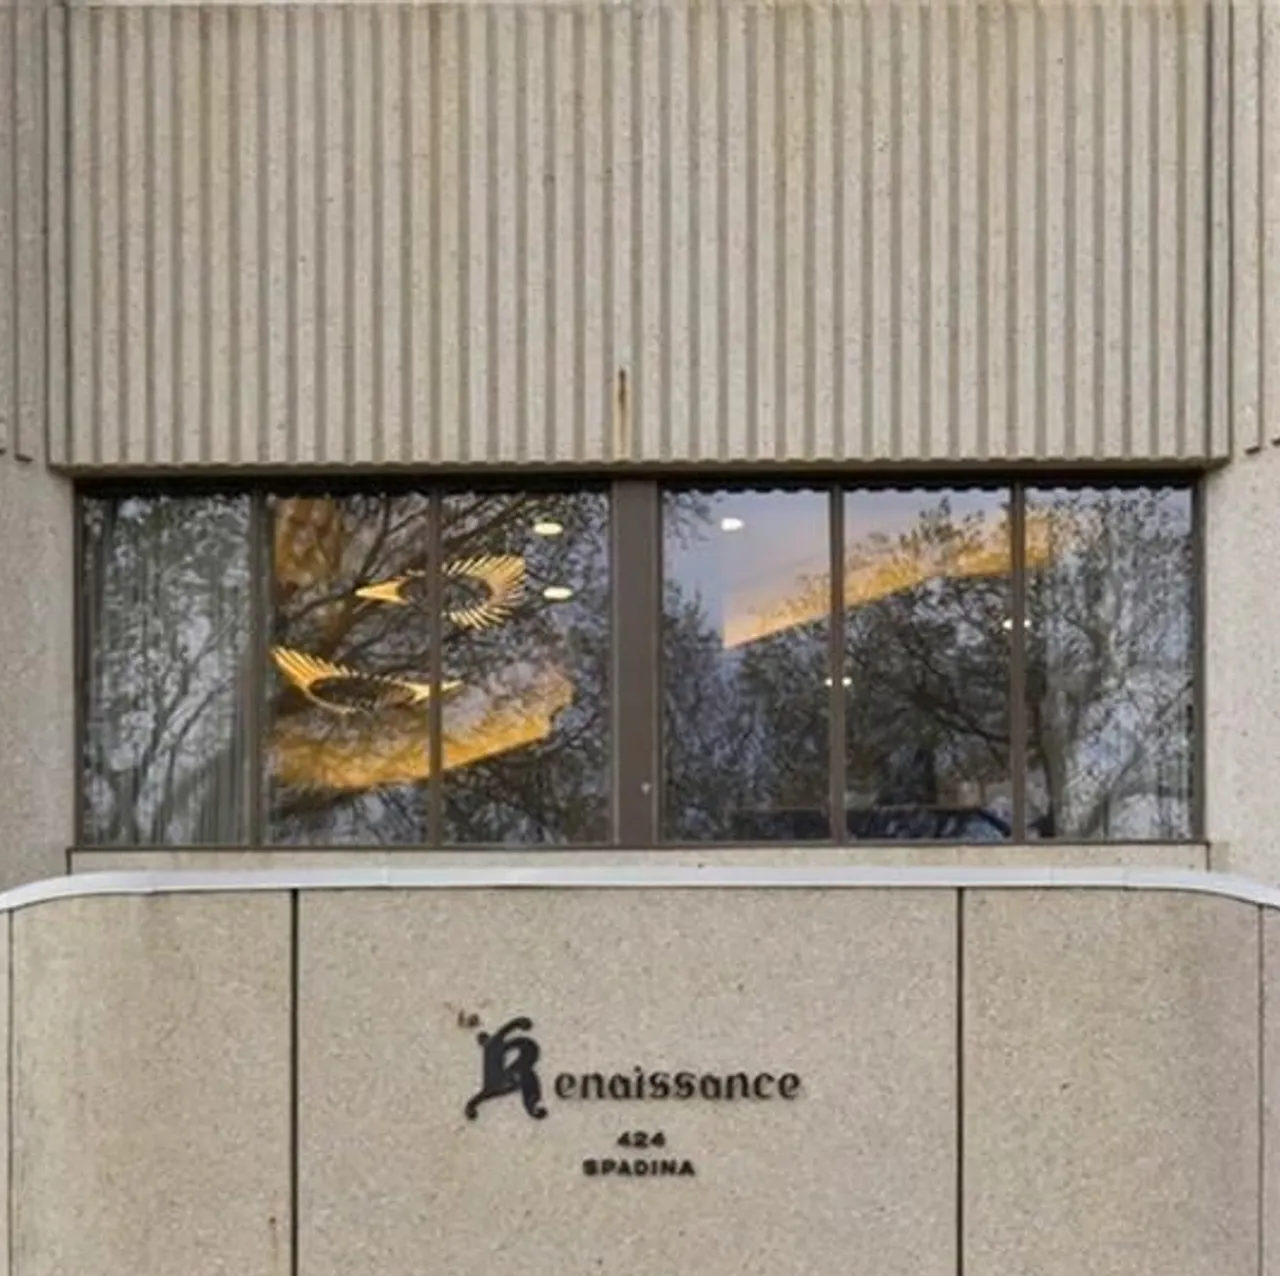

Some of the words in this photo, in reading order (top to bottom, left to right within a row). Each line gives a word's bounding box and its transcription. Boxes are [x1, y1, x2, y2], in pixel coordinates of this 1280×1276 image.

[464, 1016, 801, 1120] Renaissance
[617, 1130, 666, 1149] 424
[582, 1159, 696, 1177] SPADINA
